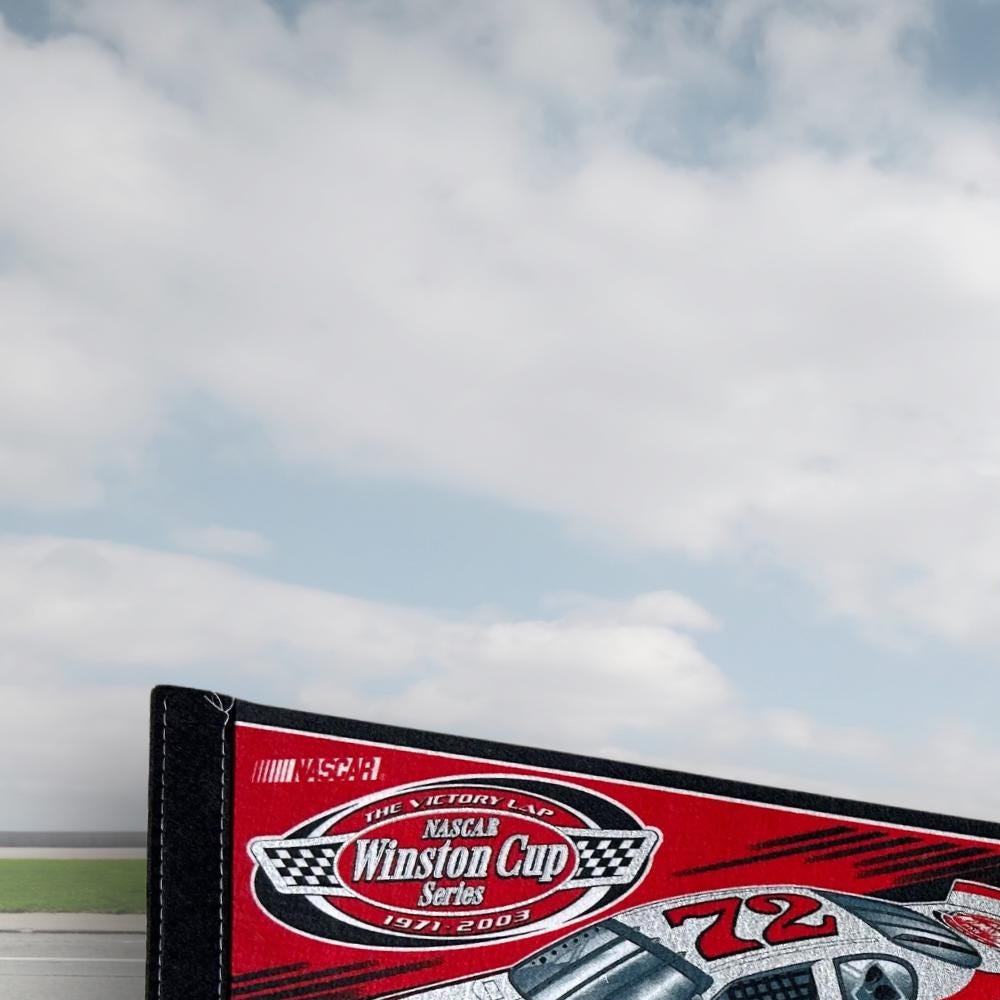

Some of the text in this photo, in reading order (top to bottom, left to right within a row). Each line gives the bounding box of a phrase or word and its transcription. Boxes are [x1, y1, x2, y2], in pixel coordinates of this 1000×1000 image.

[293, 756, 382, 783] NASCAR
[365, 793, 555, 823] THE VICTORY LAP
[422, 817, 501, 839] NASCAR
[352, 834, 570, 883] Winston Cup
[417, 881, 486, 907] Series
[664, 893, 839, 961] 72
